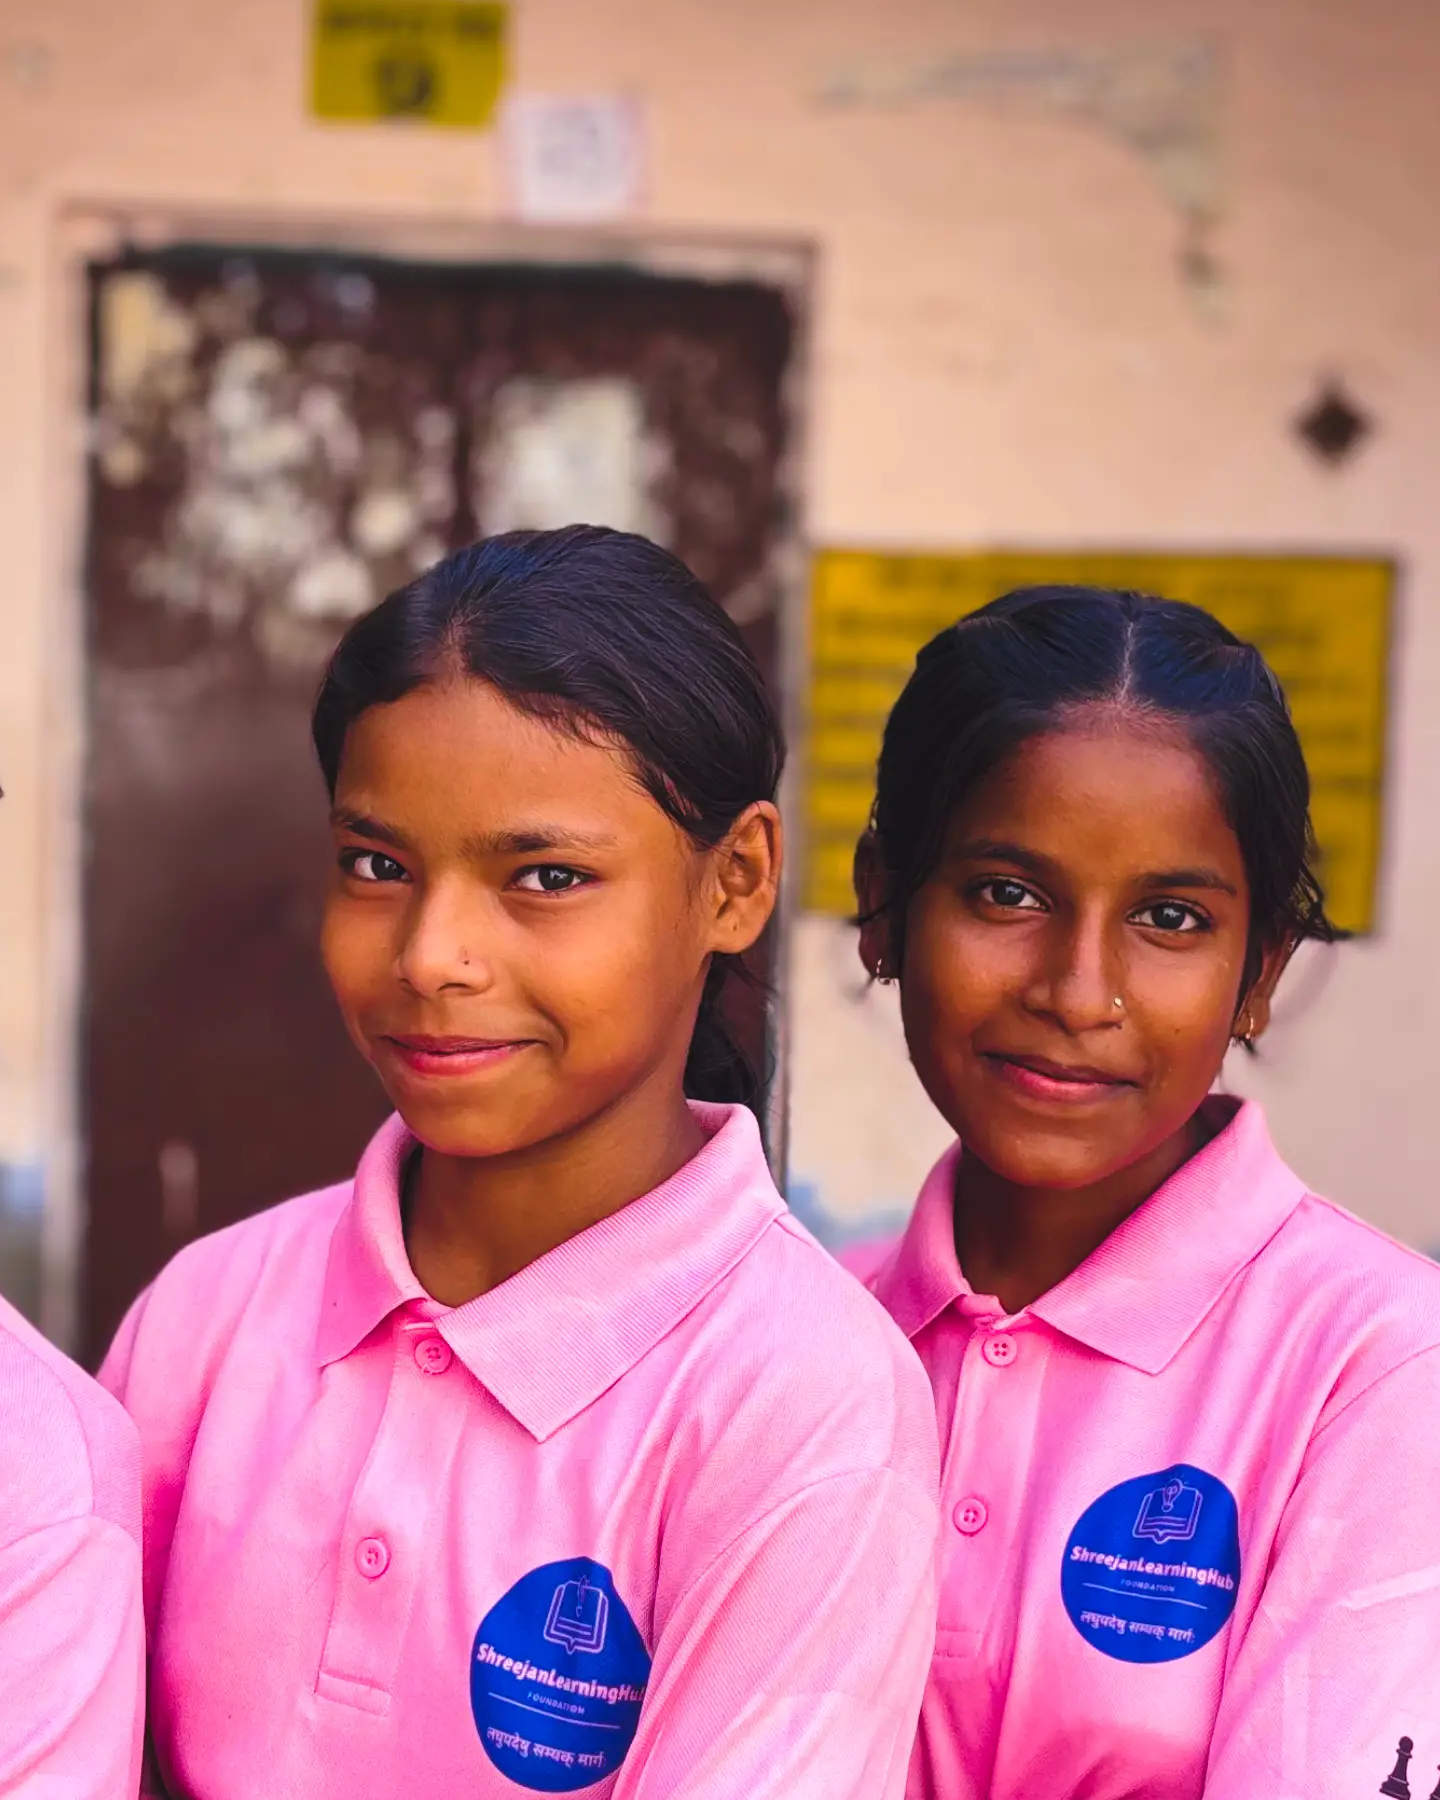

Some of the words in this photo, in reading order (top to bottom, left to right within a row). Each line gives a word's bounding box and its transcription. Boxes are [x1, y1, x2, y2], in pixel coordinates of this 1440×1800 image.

[1070, 1545, 1235, 1591] ShreejanLearningHub
[1120, 1578, 1176, 1593] FOUNDATION
[527, 1690, 586, 1716] FOUNDATION
